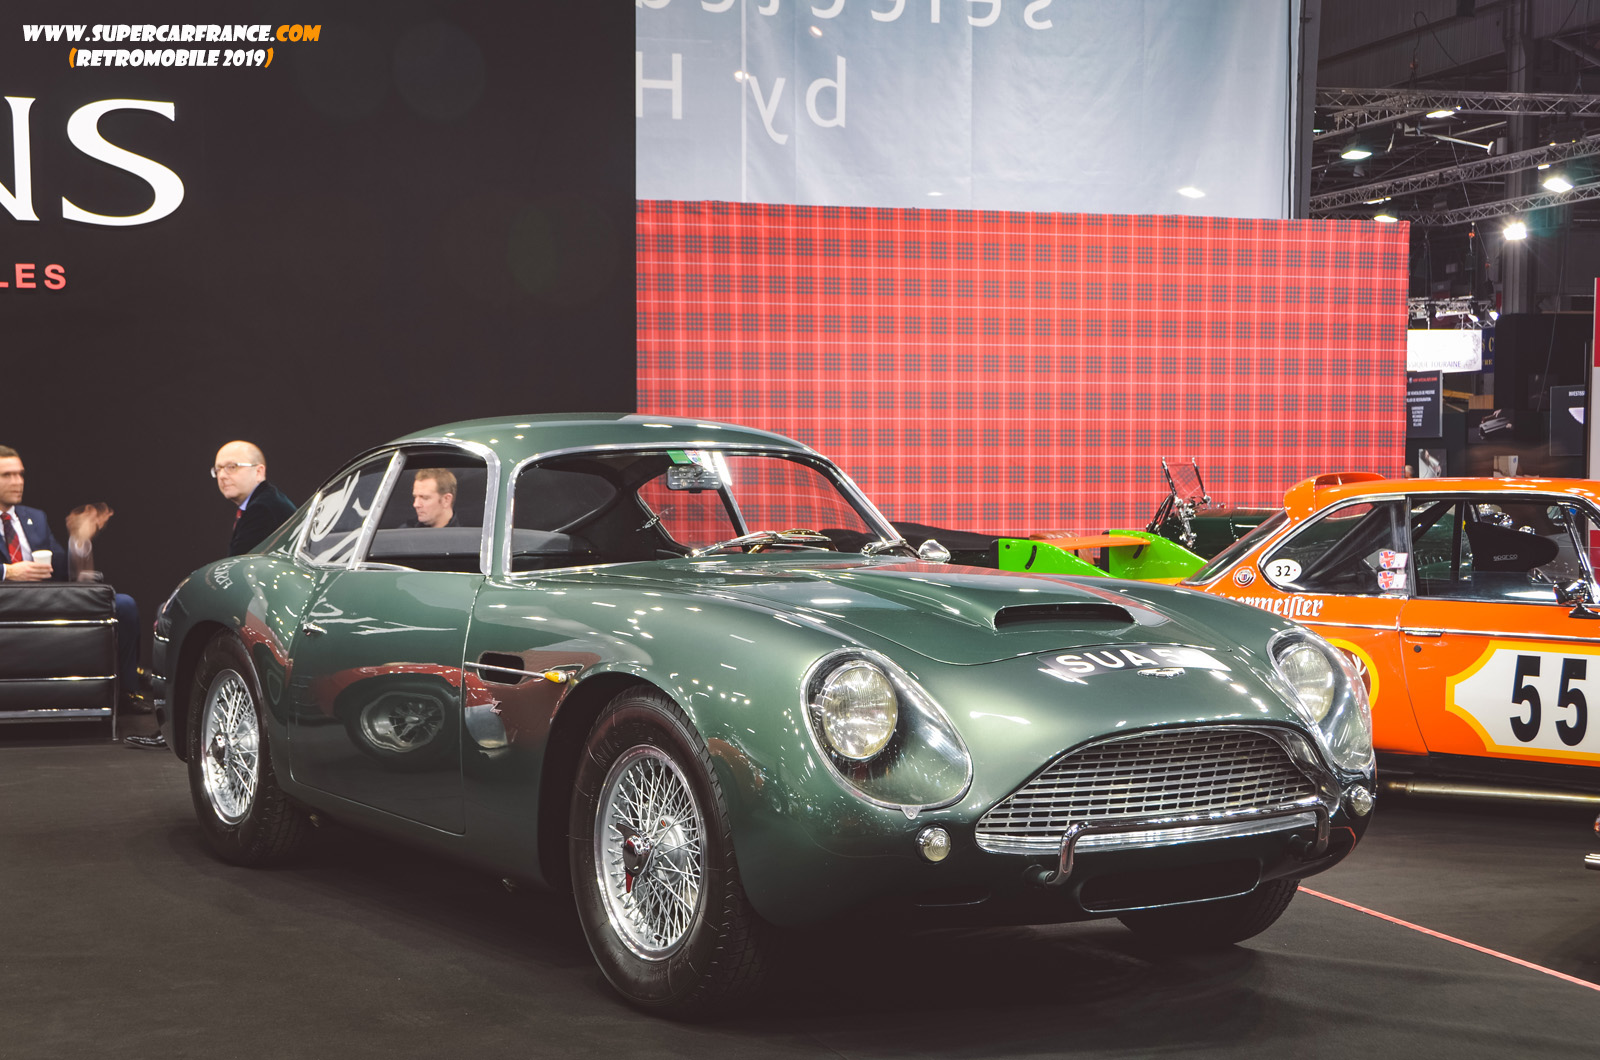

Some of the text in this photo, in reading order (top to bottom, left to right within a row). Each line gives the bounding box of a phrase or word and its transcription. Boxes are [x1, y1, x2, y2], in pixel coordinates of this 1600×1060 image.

[0, 263, 67, 290] ES
[1275, 565, 1291, 577] 32
[1055, 649, 1159, 673] SUA
[1509, 654, 1588, 746] 55
